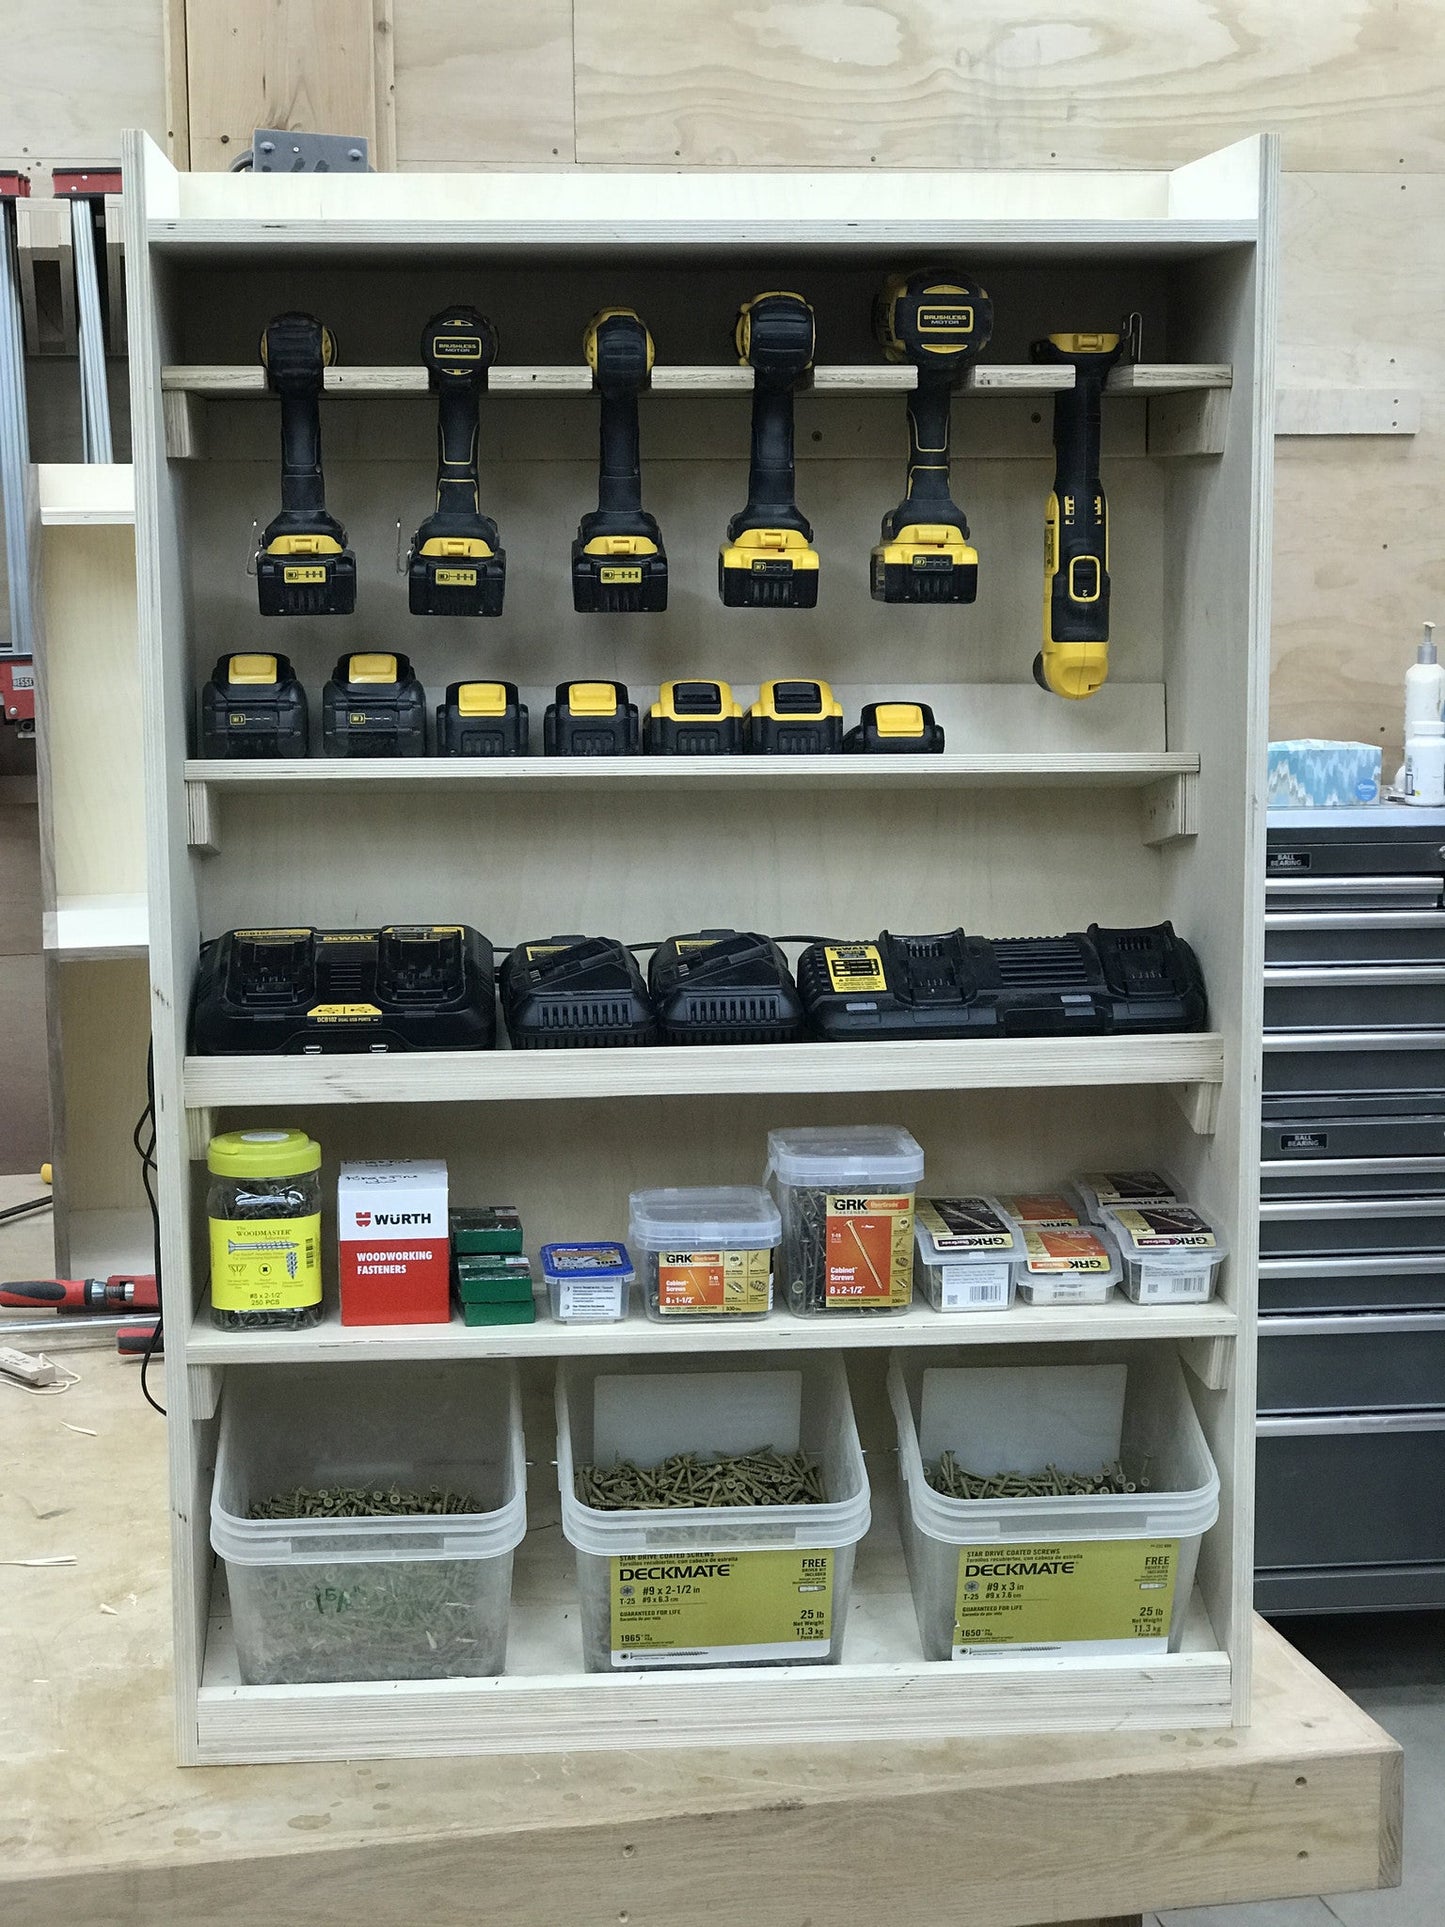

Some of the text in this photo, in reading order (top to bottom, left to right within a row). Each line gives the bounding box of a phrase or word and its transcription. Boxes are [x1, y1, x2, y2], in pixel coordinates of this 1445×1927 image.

[834, 1199, 868, 1210] GRK
[375, 1213, 431, 1225] WÜRTH
[971, 1238, 1004, 1246] GRK
[1177, 1237, 1207, 1245] GRK
[356, 1251, 433, 1262] WOODWORKING
[666, 1254, 692, 1263] GRK
[1069, 1260, 1101, 1268] GRK
[357, 1265, 407, 1275] FASTENERS
[830, 1286, 835, 1294] 8
[802, 1558, 827, 1568] FREE
[1145, 1556, 1170, 1565] FREE
[619, 1564, 730, 1581] DECKMATE
[965, 1561, 1075, 1577] DECKMATE
[642, 1586, 655, 1595] #9
[666, 1585, 692, 1595] 2-1/2
[987, 1582, 999, 1591] #9
[1009, 1582, 1016, 1590] 3
[800, 1610, 825, 1619] 25 lb
[1140, 1607, 1164, 1616] 25 lb
[796, 1627, 813, 1635] 11.3
[620, 1634, 641, 1642] 1965
